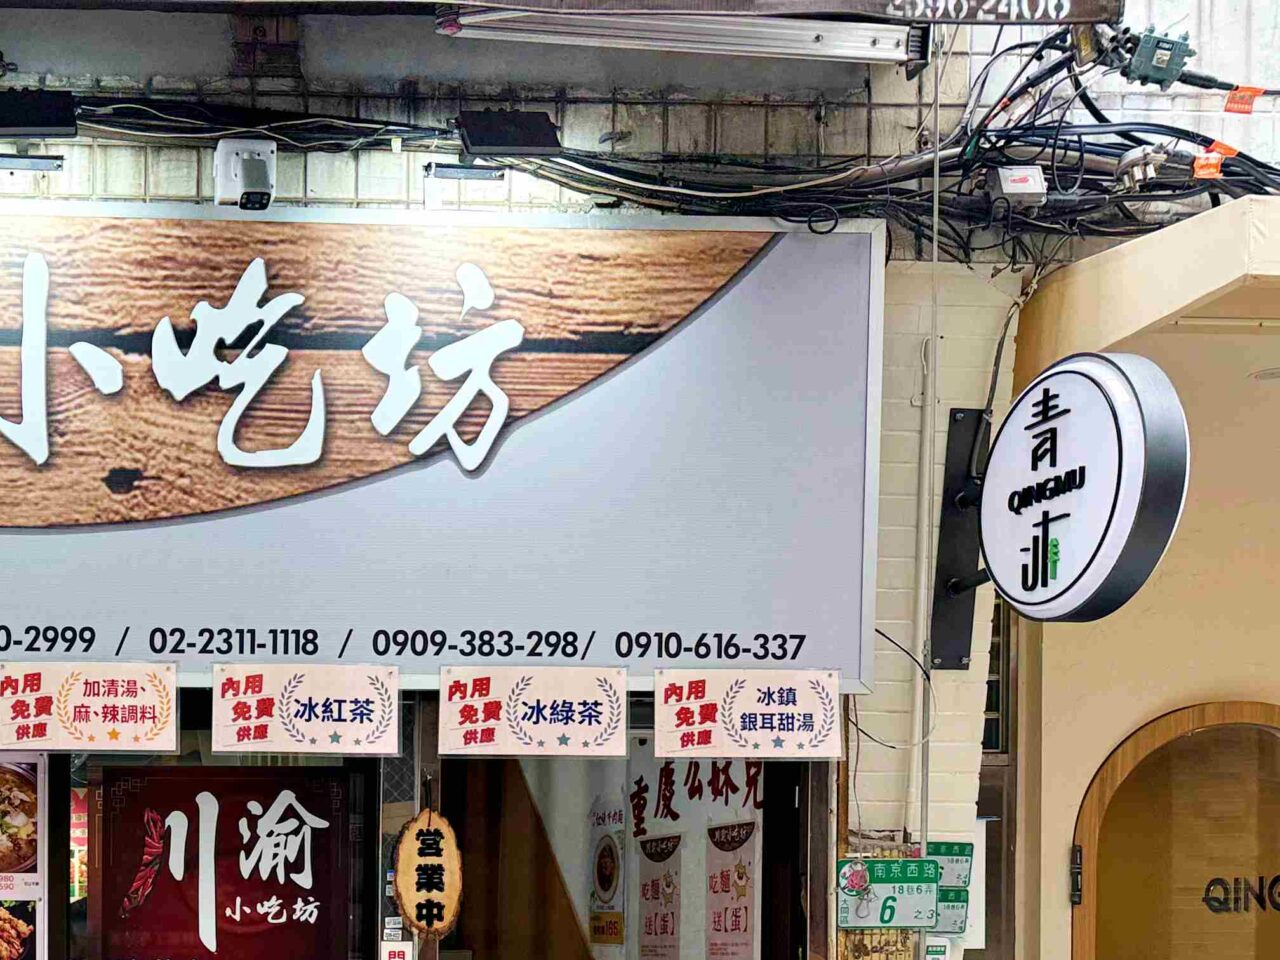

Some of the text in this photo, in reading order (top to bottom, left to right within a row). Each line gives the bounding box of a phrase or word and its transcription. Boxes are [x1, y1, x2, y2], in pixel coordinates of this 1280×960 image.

[1007, 466, 1086, 515] QINGMU
[148, 627, 320, 655] 02-2311-1118
[615, 631, 807, 660] 0910-616-337
[756, 686, 798, 707] 冰鎮
[10, 697, 54, 721] 免費
[72, 703, 158, 724] 麻、辣調料
[231, 698, 275, 722] 免費
[293, 697, 376, 725] 冰紅茶
[458, 700, 503, 726] 免費
[521, 699, 604, 726] 冰綠茶
[674, 702, 718, 727] 免費
[15, 722, 48, 741] 供應
[236, 725, 270, 742] 供應
[740, 711, 815, 733] 銀耳甜湯
[462, 727, 497, 746] 供應
[679, 730, 712, 748] 供應
[122, 789, 330, 953] 川渝
[709, 869, 731, 894] 吃麵
[874, 862, 936, 879] 南京西路
[641, 879, 661, 901] 吃麵
[892, 885, 934, 896] 18巷6弄
[225, 895, 321, 924] 小吃坊
[879, 895, 898, 924] 6
